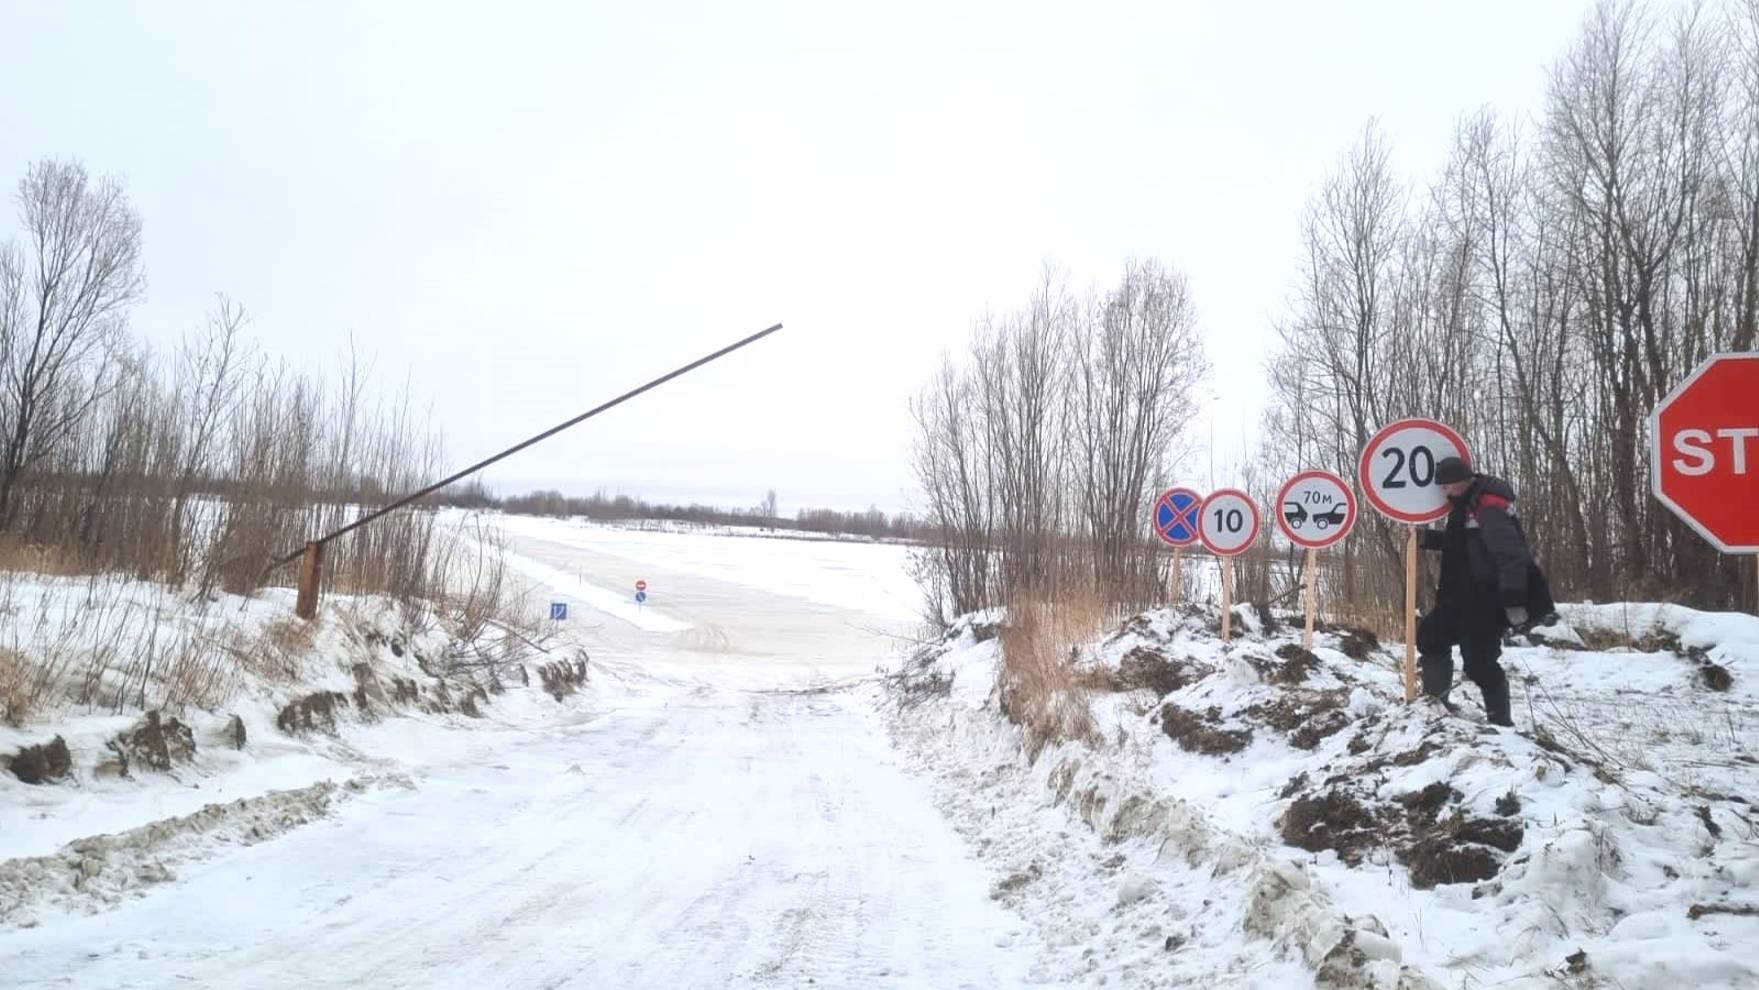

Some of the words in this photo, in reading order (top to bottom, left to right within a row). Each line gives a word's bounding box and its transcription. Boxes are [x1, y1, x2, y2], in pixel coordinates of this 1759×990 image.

[1381, 445, 1436, 489] 20
[1672, 428, 1759, 476] ST
[1214, 509, 1244, 533] 10
